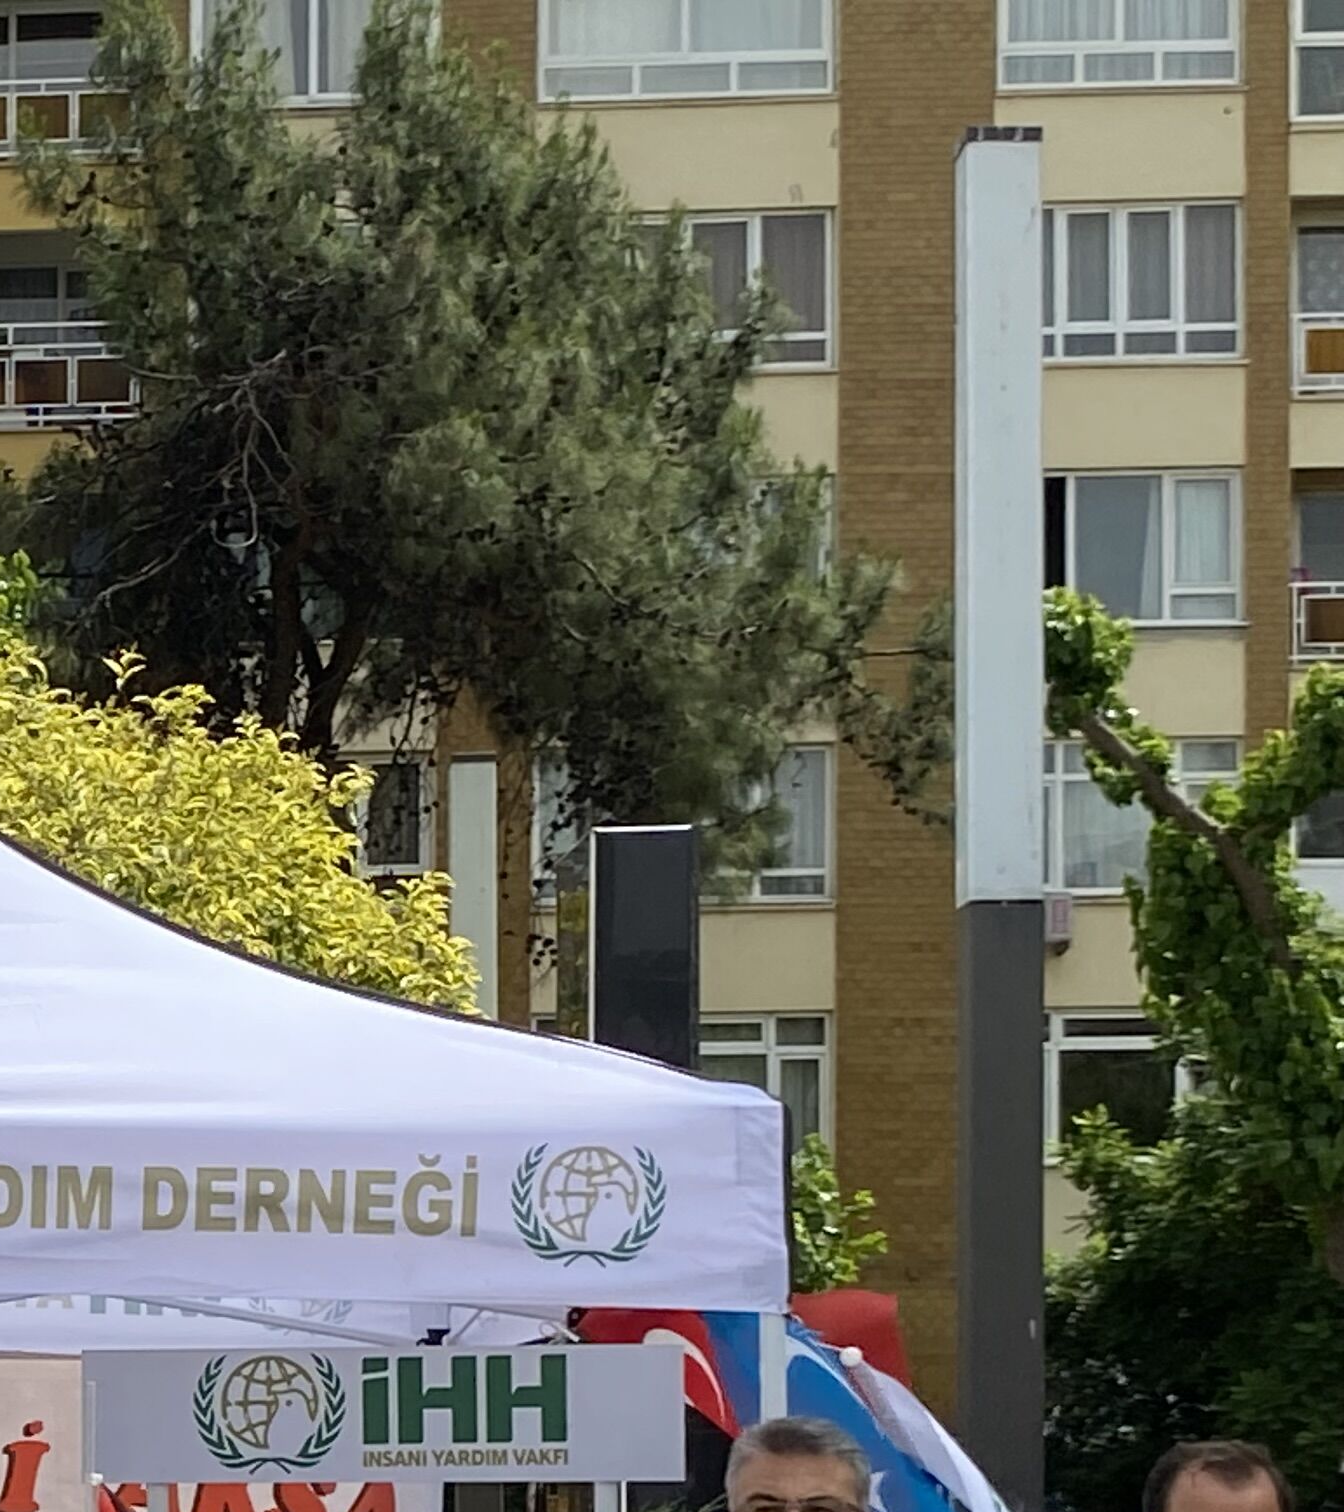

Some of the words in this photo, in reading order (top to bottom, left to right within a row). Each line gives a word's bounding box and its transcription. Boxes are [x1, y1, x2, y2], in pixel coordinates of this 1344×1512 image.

[141, 1154, 478, 1238] DERNEĞİ
[431, 1450, 508, 1466] YARDIM
[513, 1449, 569, 1465] VAKFI
